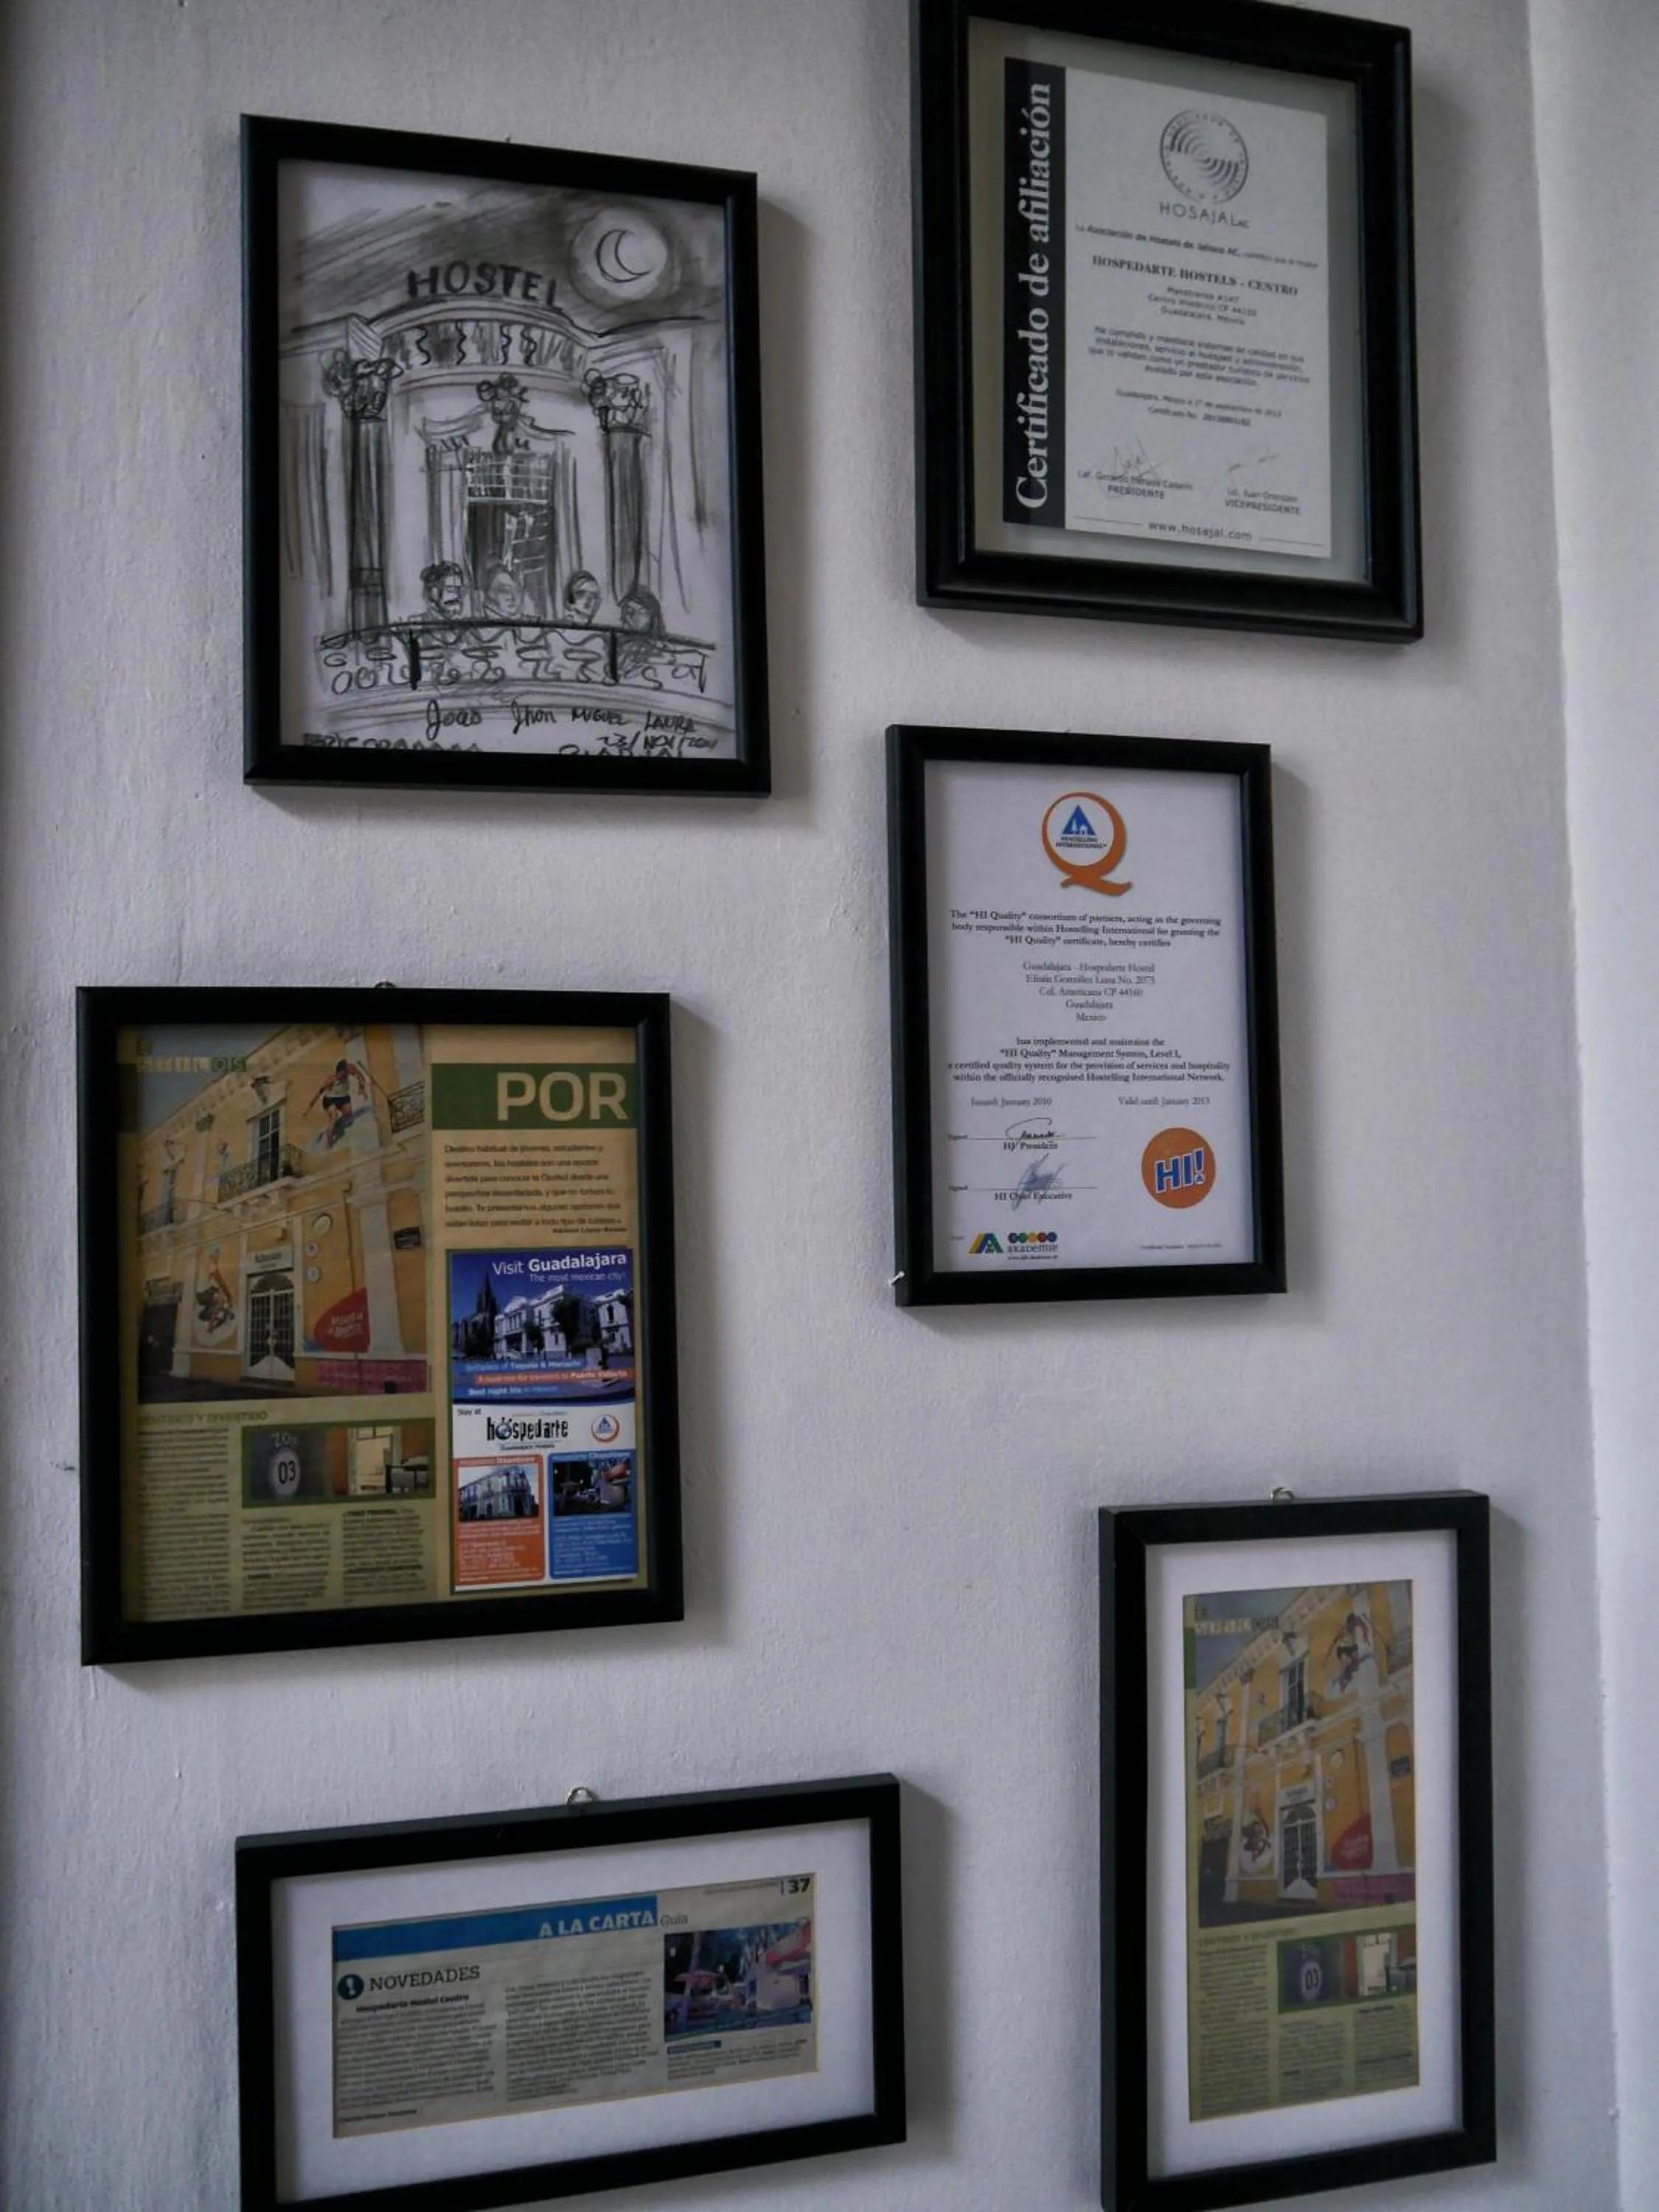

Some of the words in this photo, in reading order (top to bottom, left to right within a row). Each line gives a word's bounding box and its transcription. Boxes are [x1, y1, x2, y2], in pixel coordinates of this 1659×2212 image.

[1018, 83, 1051, 243] afiliación
[406, 260, 566, 313] HOSTEL
[1018, 252, 1050, 296] de
[1092, 254, 1176, 279] HOSPEDARTE
[1179, 268, 1237, 288] HOSTELS
[1248, 279, 1298, 296] CENTRO
[1016, 307, 1049, 509] Certificado
[1107, 484, 1166, 501] PRESIDENTE
[1147, 520, 1253, 542] www.hosajal.com
[496, 1071, 627, 1121] POR
[1153, 1147, 1206, 1194] HI!
[492, 1260, 525, 1276] Visit
[528, 1252, 627, 1273] Guadalajara
[278, 1460, 296, 1485] 03
[787, 1877, 812, 1894] 37
[539, 1923, 554, 1938] A
[557, 1918, 583, 1937] LA
[589, 1910, 656, 1931] CARTA
[369, 1964, 481, 1992] NOVEDADES
